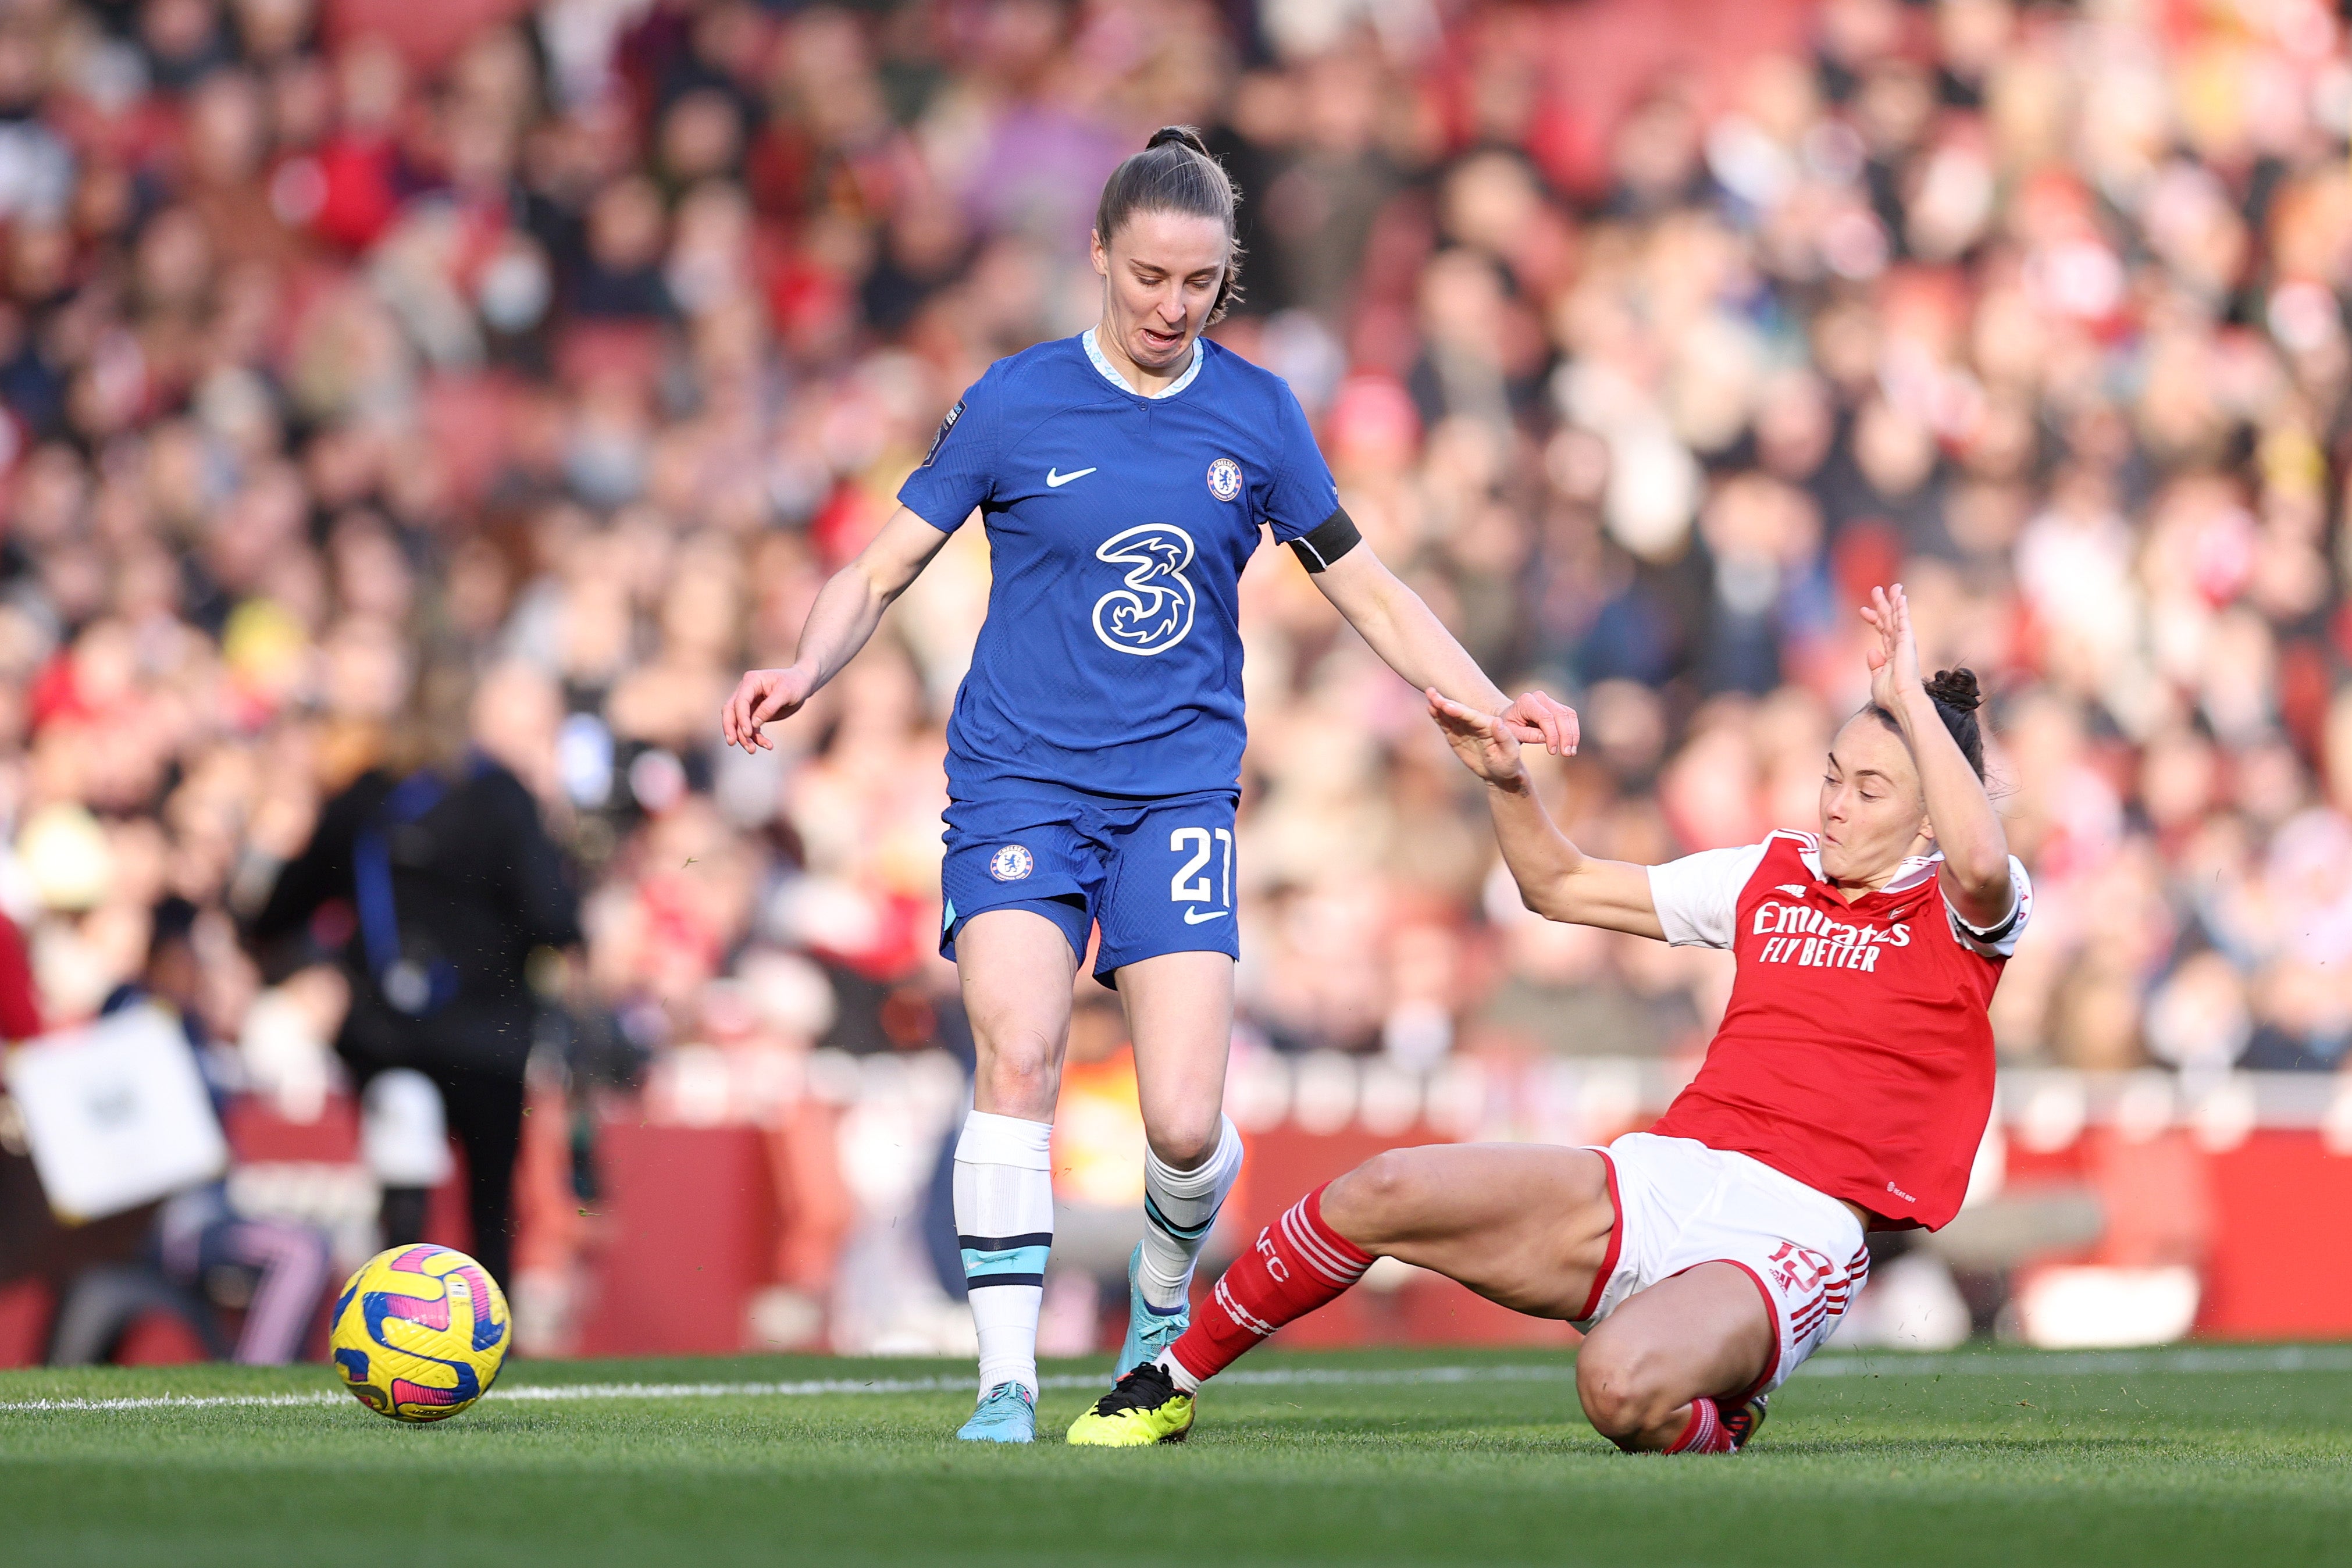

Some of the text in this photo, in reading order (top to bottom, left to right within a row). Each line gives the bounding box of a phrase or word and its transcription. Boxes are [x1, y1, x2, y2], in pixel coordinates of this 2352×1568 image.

[1213, 460, 1236, 471] CHELSEA
[997, 846, 1025, 856] CHELSEA
[1170, 827, 1232, 908] 21
[1753, 901, 1911, 947] Emirates
[1759, 937, 1880, 972] FLY BETTER
